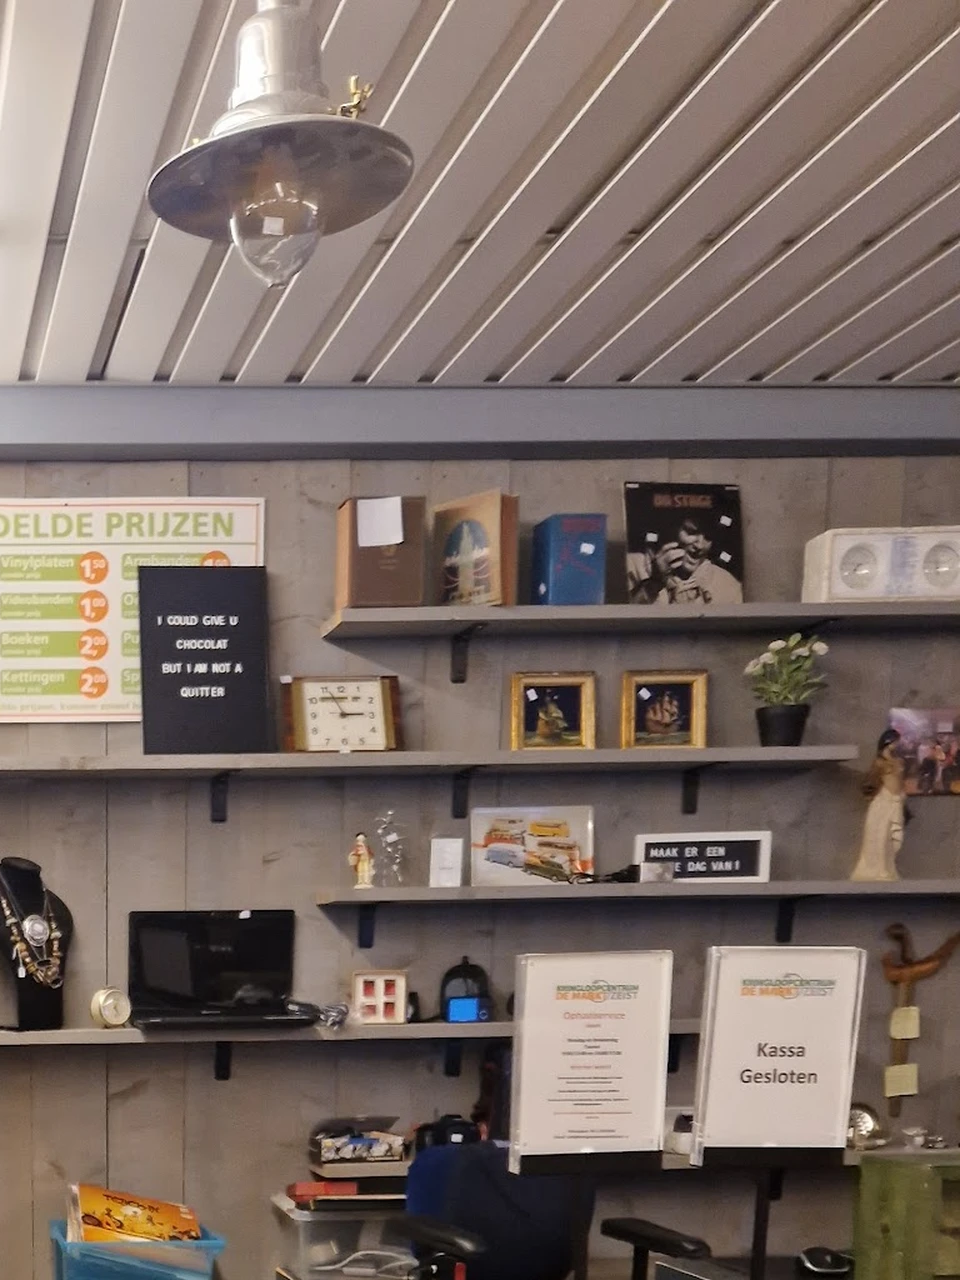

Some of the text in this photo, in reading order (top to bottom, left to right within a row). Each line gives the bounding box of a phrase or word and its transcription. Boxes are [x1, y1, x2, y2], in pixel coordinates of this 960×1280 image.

[105, 511, 234, 538] PRIJZEN
[1, 556, 74, 571] Vinylplaten
[1, 594, 74, 605] Videobanden
[166, 615, 199, 626] COULD
[202, 615, 227, 626] GIVE
[229, 615, 239, 626] U
[2, 633, 49, 645] Boeken
[175, 639, 229, 650] CHOCOLAT
[161, 663, 182, 674] BUT
[193, 663, 208, 673] AM
[211, 663, 232, 674] NOT
[234, 663, 243, 673] A
[2, 671, 65, 686] Kettingen
[180, 686, 226, 698] QUITTER
[649, 846, 726, 858] MAAK ER EEN
[687, 861, 707, 872] DAG
[757, 1042, 806, 1058] Kassa
[740, 1068, 818, 1084] Gesloten
